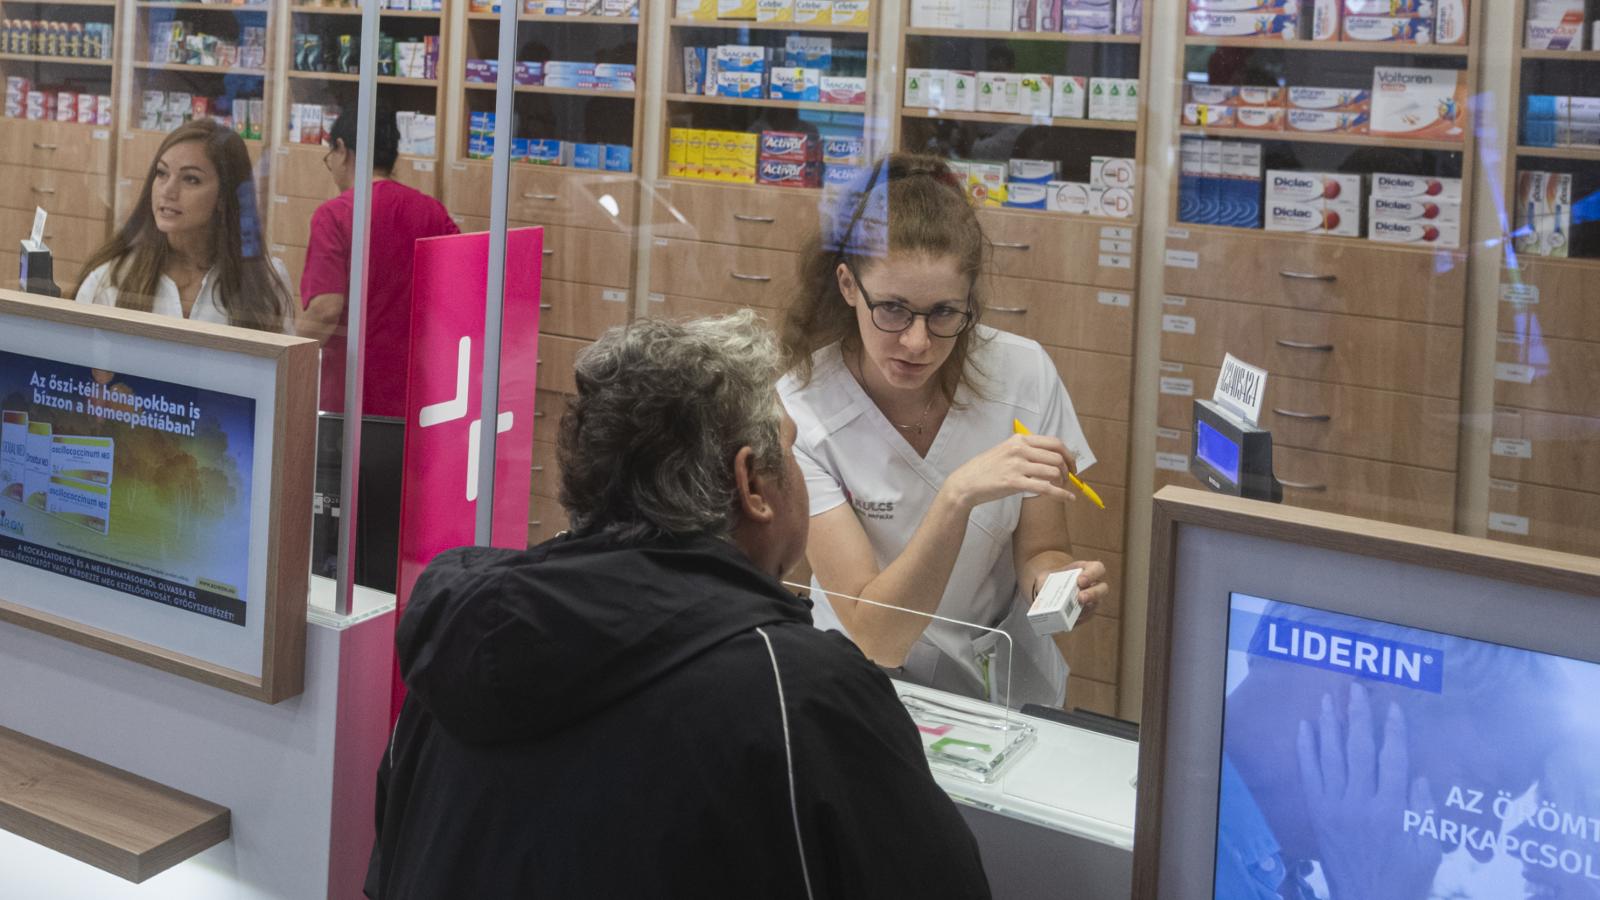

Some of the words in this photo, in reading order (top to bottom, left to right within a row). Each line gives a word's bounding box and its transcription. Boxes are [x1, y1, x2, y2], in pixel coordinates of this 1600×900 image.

[1378, 71, 1433, 84] Voltaren
[1274, 177, 1313, 188] Diclac
[1378, 177, 1415, 188] Diclac
[1375, 200, 1412, 210] Diclac
[1273, 207, 1312, 218] Diclac
[1375, 222, 1412, 233] Diclac
[30, 370, 46, 389] Az
[49, 373, 100, 398] őszi-téli
[102, 383, 185, 414] hónapokban
[189, 401, 201, 419] is
[33, 389, 73, 413] bízzon
[75, 402, 84, 414] a
[87, 399, 196, 437] homeopátiában!
[158, 583, 187, 596] OLVASSA
[188, 591, 197, 600] EL
[1445, 785, 1484, 815] AZ
[1492, 789, 1600, 843] ÖÖMT
[1403, 809, 1600, 880] PÁRKAPCSOL
